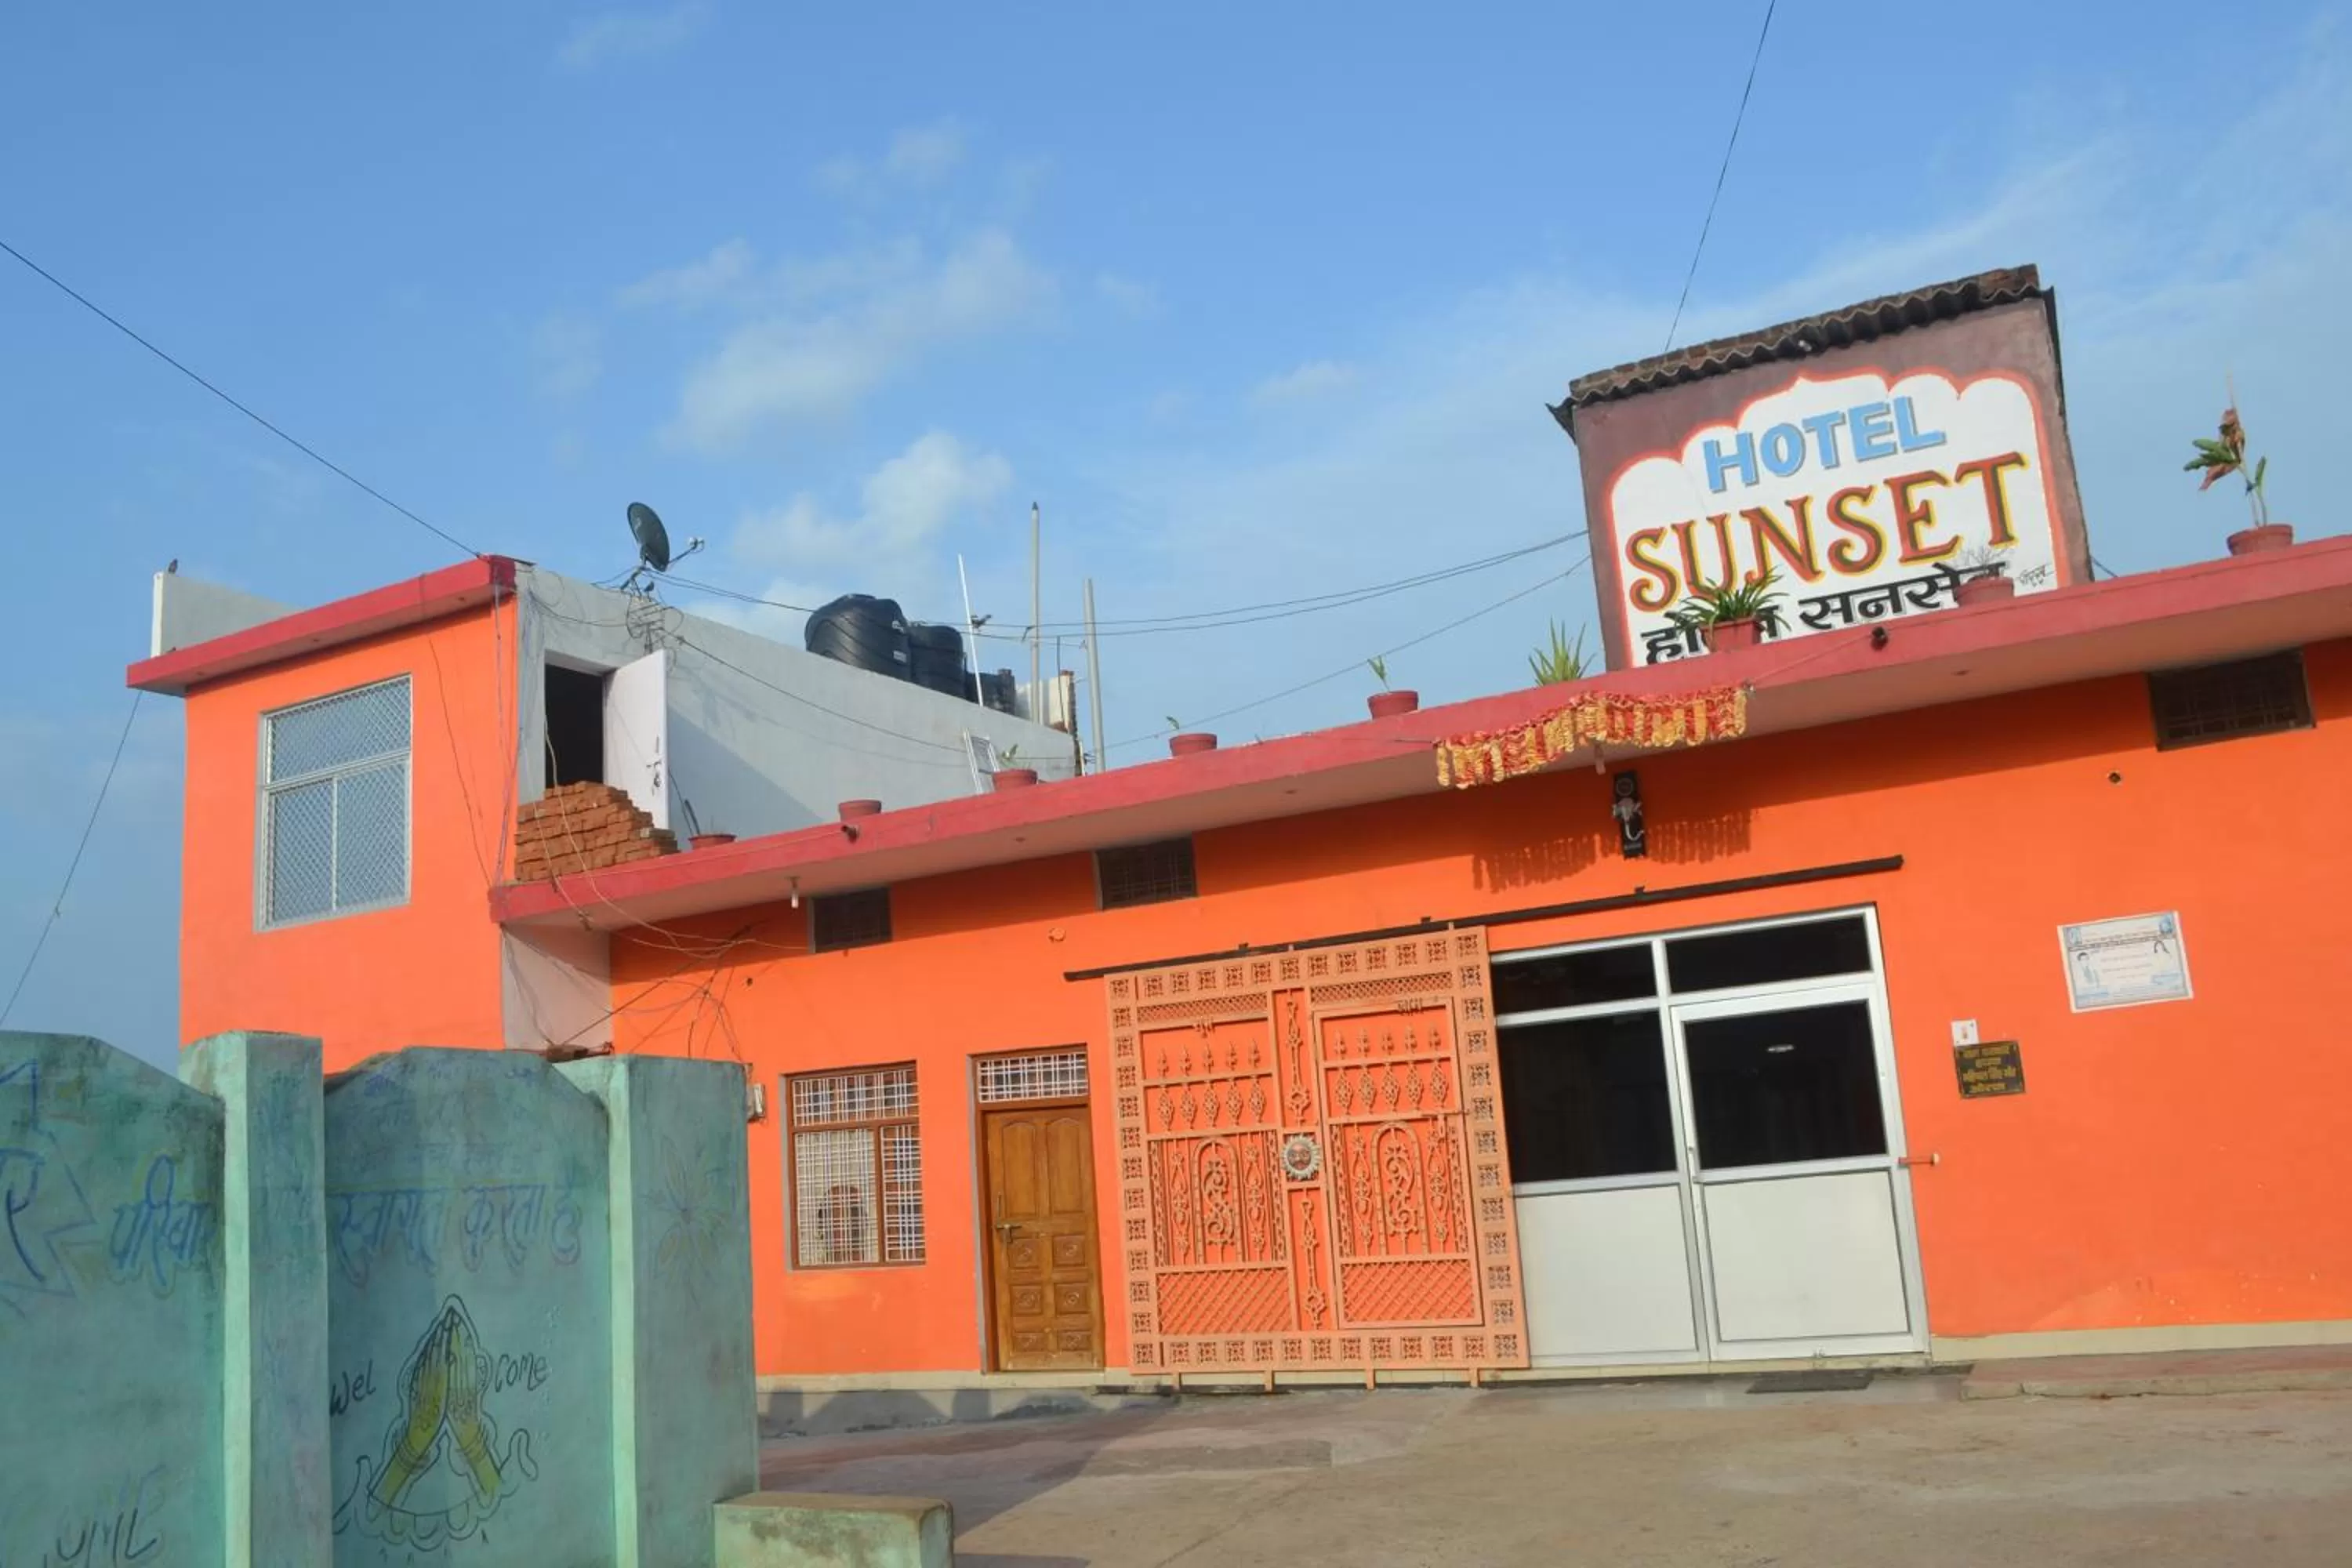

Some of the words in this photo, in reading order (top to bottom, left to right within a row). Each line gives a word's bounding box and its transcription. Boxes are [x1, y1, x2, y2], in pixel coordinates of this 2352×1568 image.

[1703, 396, 1947, 494] HOTEL
[1624, 451, 2031, 614] SUNSET
[328, 1359, 376, 1417] Wel
